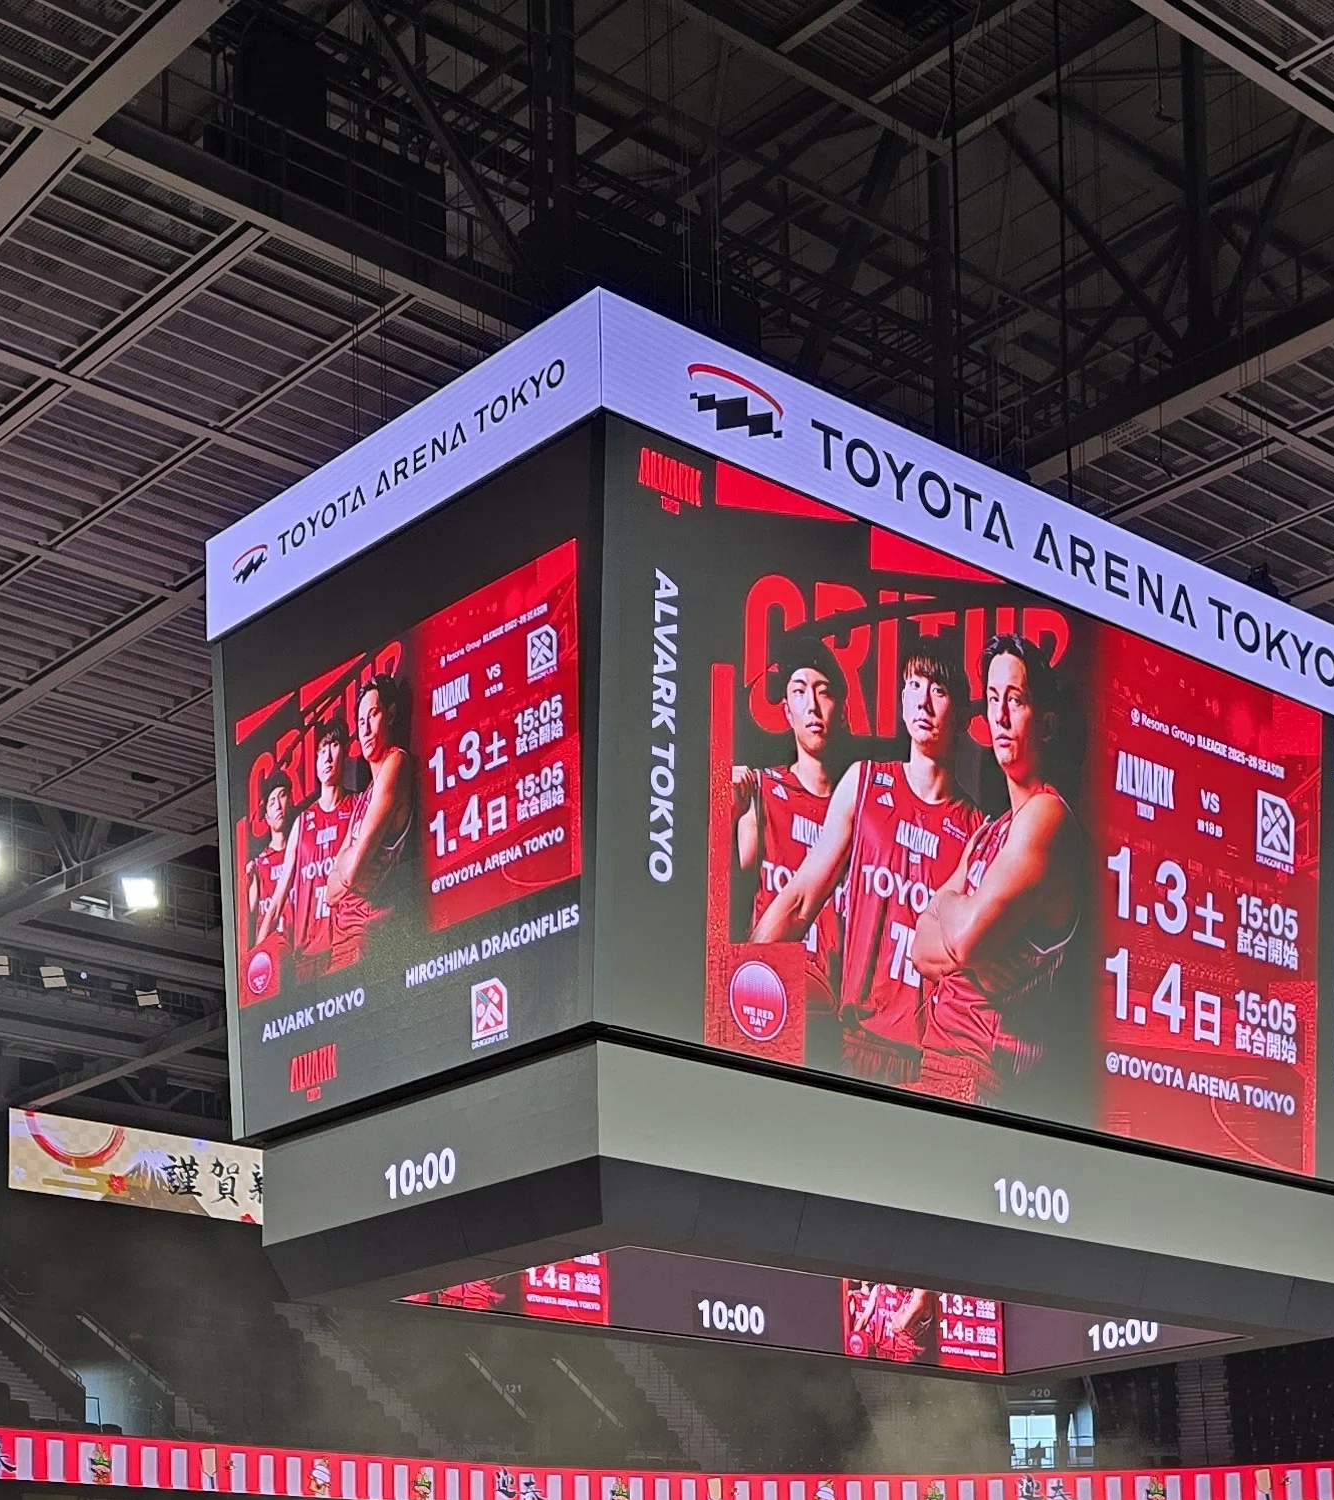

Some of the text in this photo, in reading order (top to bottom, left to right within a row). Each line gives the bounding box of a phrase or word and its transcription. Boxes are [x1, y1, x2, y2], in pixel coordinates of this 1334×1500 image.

[278, 358, 566, 556] TOYOTA ARENA TOKYO
[810, 418, 1014, 550] TOYOTA
[1034, 524, 1197, 630] ARENA
[486, 663, 501, 680] VS
[514, 695, 563, 732] 15:05
[648, 567, 680, 883] ALVARK TOKYO
[1141, 712, 1169, 735] Resona
[1171, 725, 1196, 746] Group
[515, 761, 564, 800] 15:05
[1116, 750, 1175, 809] ALVARK
[1200, 789, 1220, 814] VS
[431, 826, 564, 893] @TOYOTA ARENA TOKYO
[862, 864, 937, 914] TOYO
[1236, 893, 1298, 940] 15:05
[405, 904, 580, 989] HIROSHIMA DRAGONFLIES
[1236, 927, 1299, 971] 試合開始
[261, 988, 365, 1043] ALVARK TOKYO
[1234, 990, 1297, 1035] 15:05
[1234, 1023, 1297, 1065] 試合開始
[1106, 1052, 1295, 1116] @TOYOTA ARENA TOKYO
[384, 1147, 456, 1200] 10:00
[993, 1177, 1070, 1224] 10:00
[698, 1298, 765, 1335] 10:00
[1088, 1320, 1158, 1353] 10:00
[1030, 1388, 1050, 1398] 420
